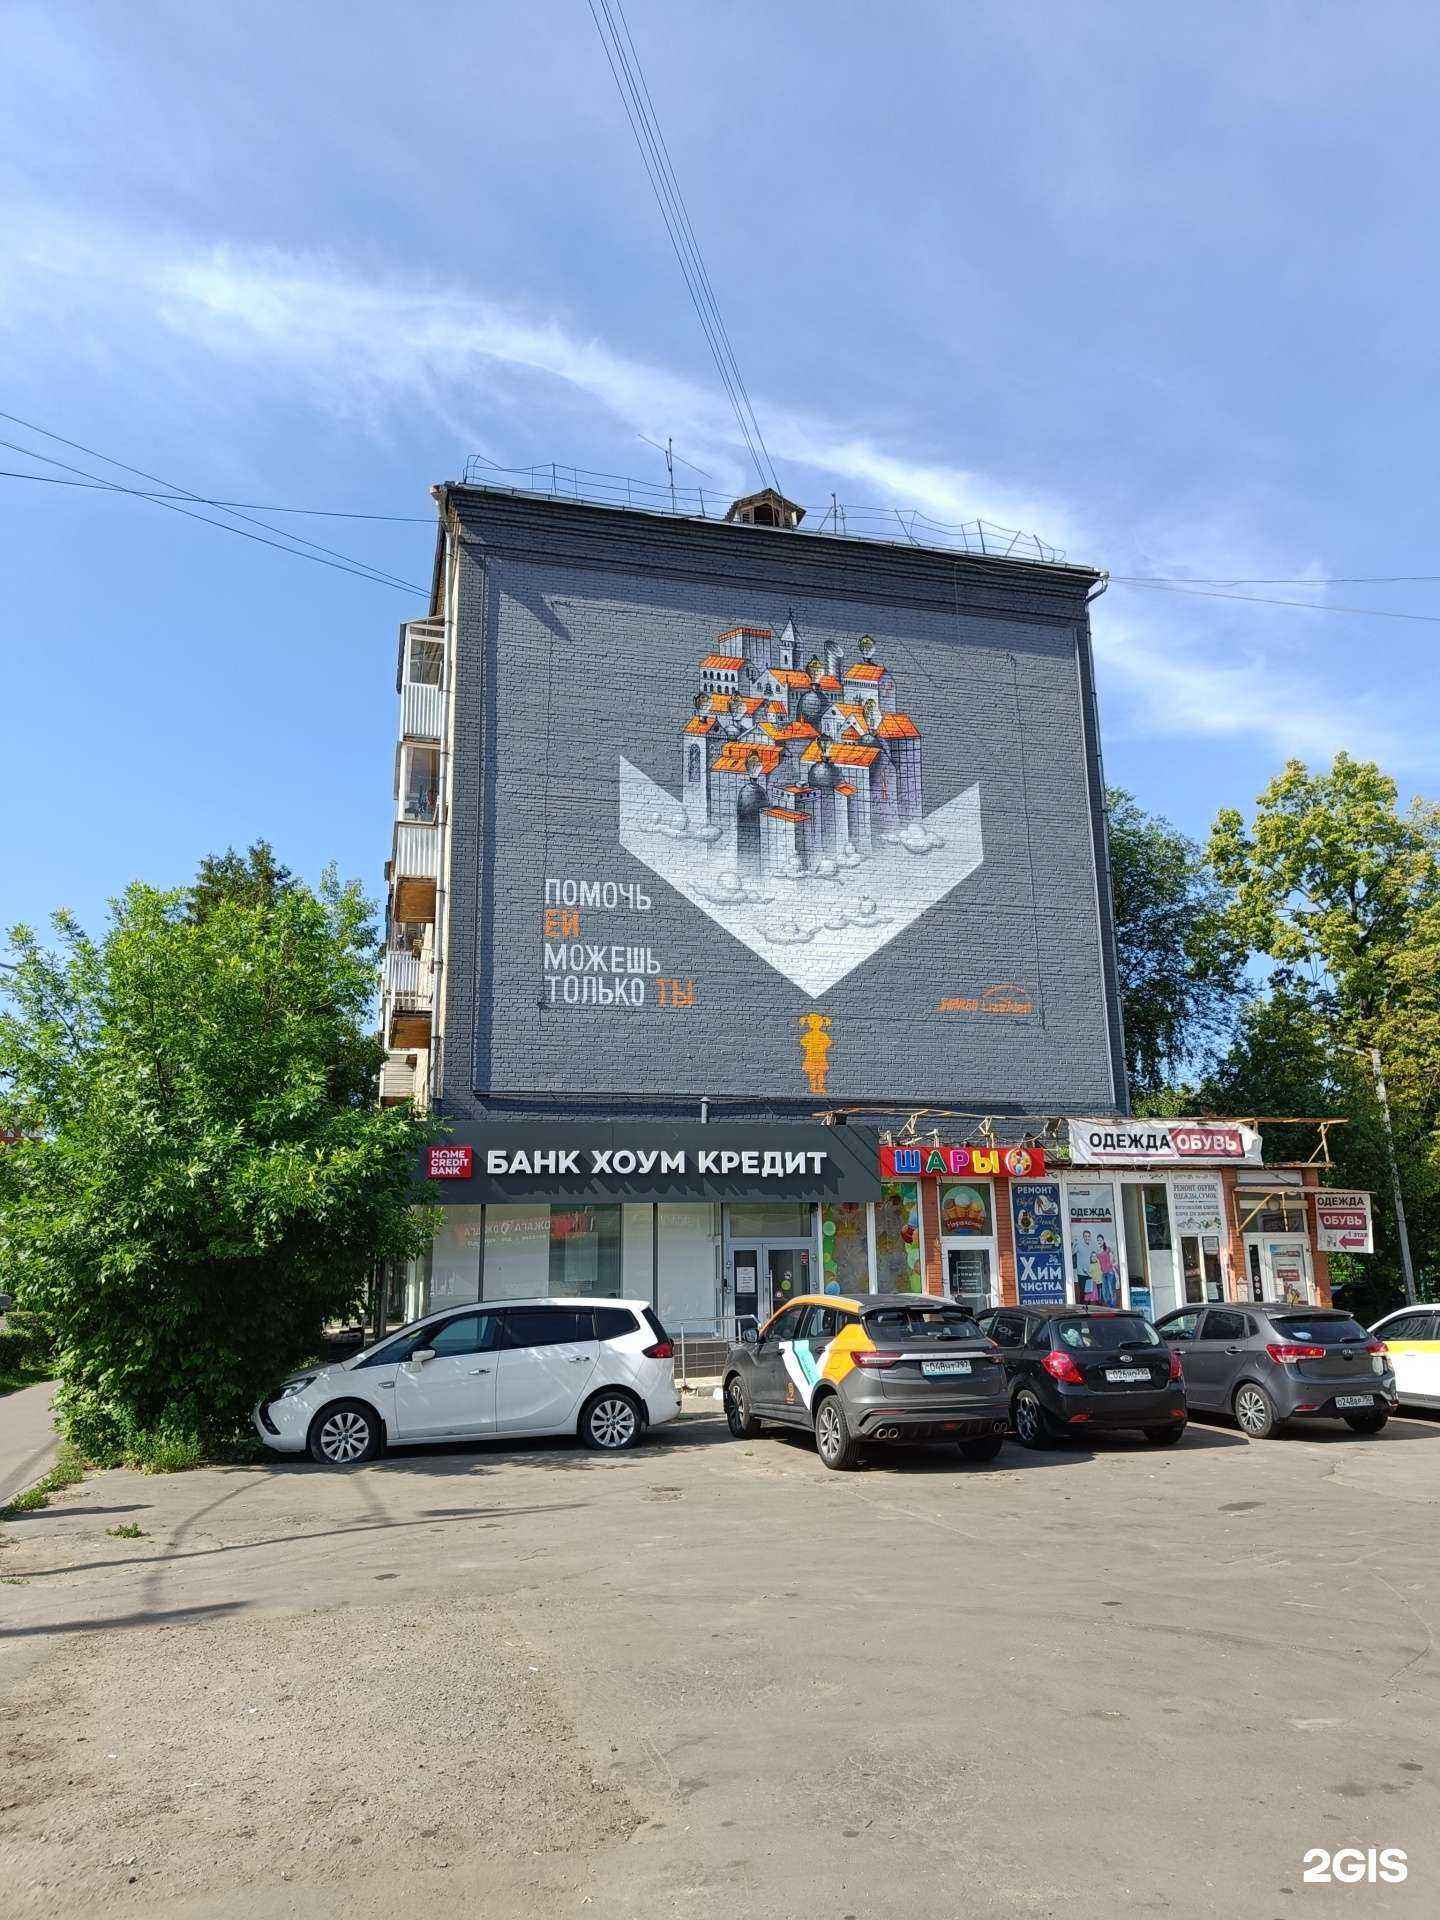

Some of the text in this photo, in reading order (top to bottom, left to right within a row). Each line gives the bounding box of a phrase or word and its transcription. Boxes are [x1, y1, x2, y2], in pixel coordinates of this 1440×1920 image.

[544, 878, 652, 910] ПОМОЧЬ
[544, 943, 661, 975] МОЖЕШЬ
[544, 975, 698, 1008] ТОЛЬКО ТЫ
[1089, 1132, 1237, 1151] ОДЕЖДА ОБУВЬ
[431, 1150, 465, 1159] HOME
[431, 1158, 469, 1167] CREDIT
[487, 1150, 828, 1178] БАНК ХОУМ КРЕДИТ
[894, 1149, 1000, 1174] ШАРЫ
[431, 1166, 461, 1175] BANK
[1017, 1186, 1053, 1195] РЕМОНТ
[1317, 1197, 1365, 1207] ОДЕЖДА
[1070, 1207, 1112, 1217] ОДЕЖДА
[1323, 1215, 1363, 1226] ОБУВЬ
[1020, 1281, 1063, 1292] ЧИСТКА
